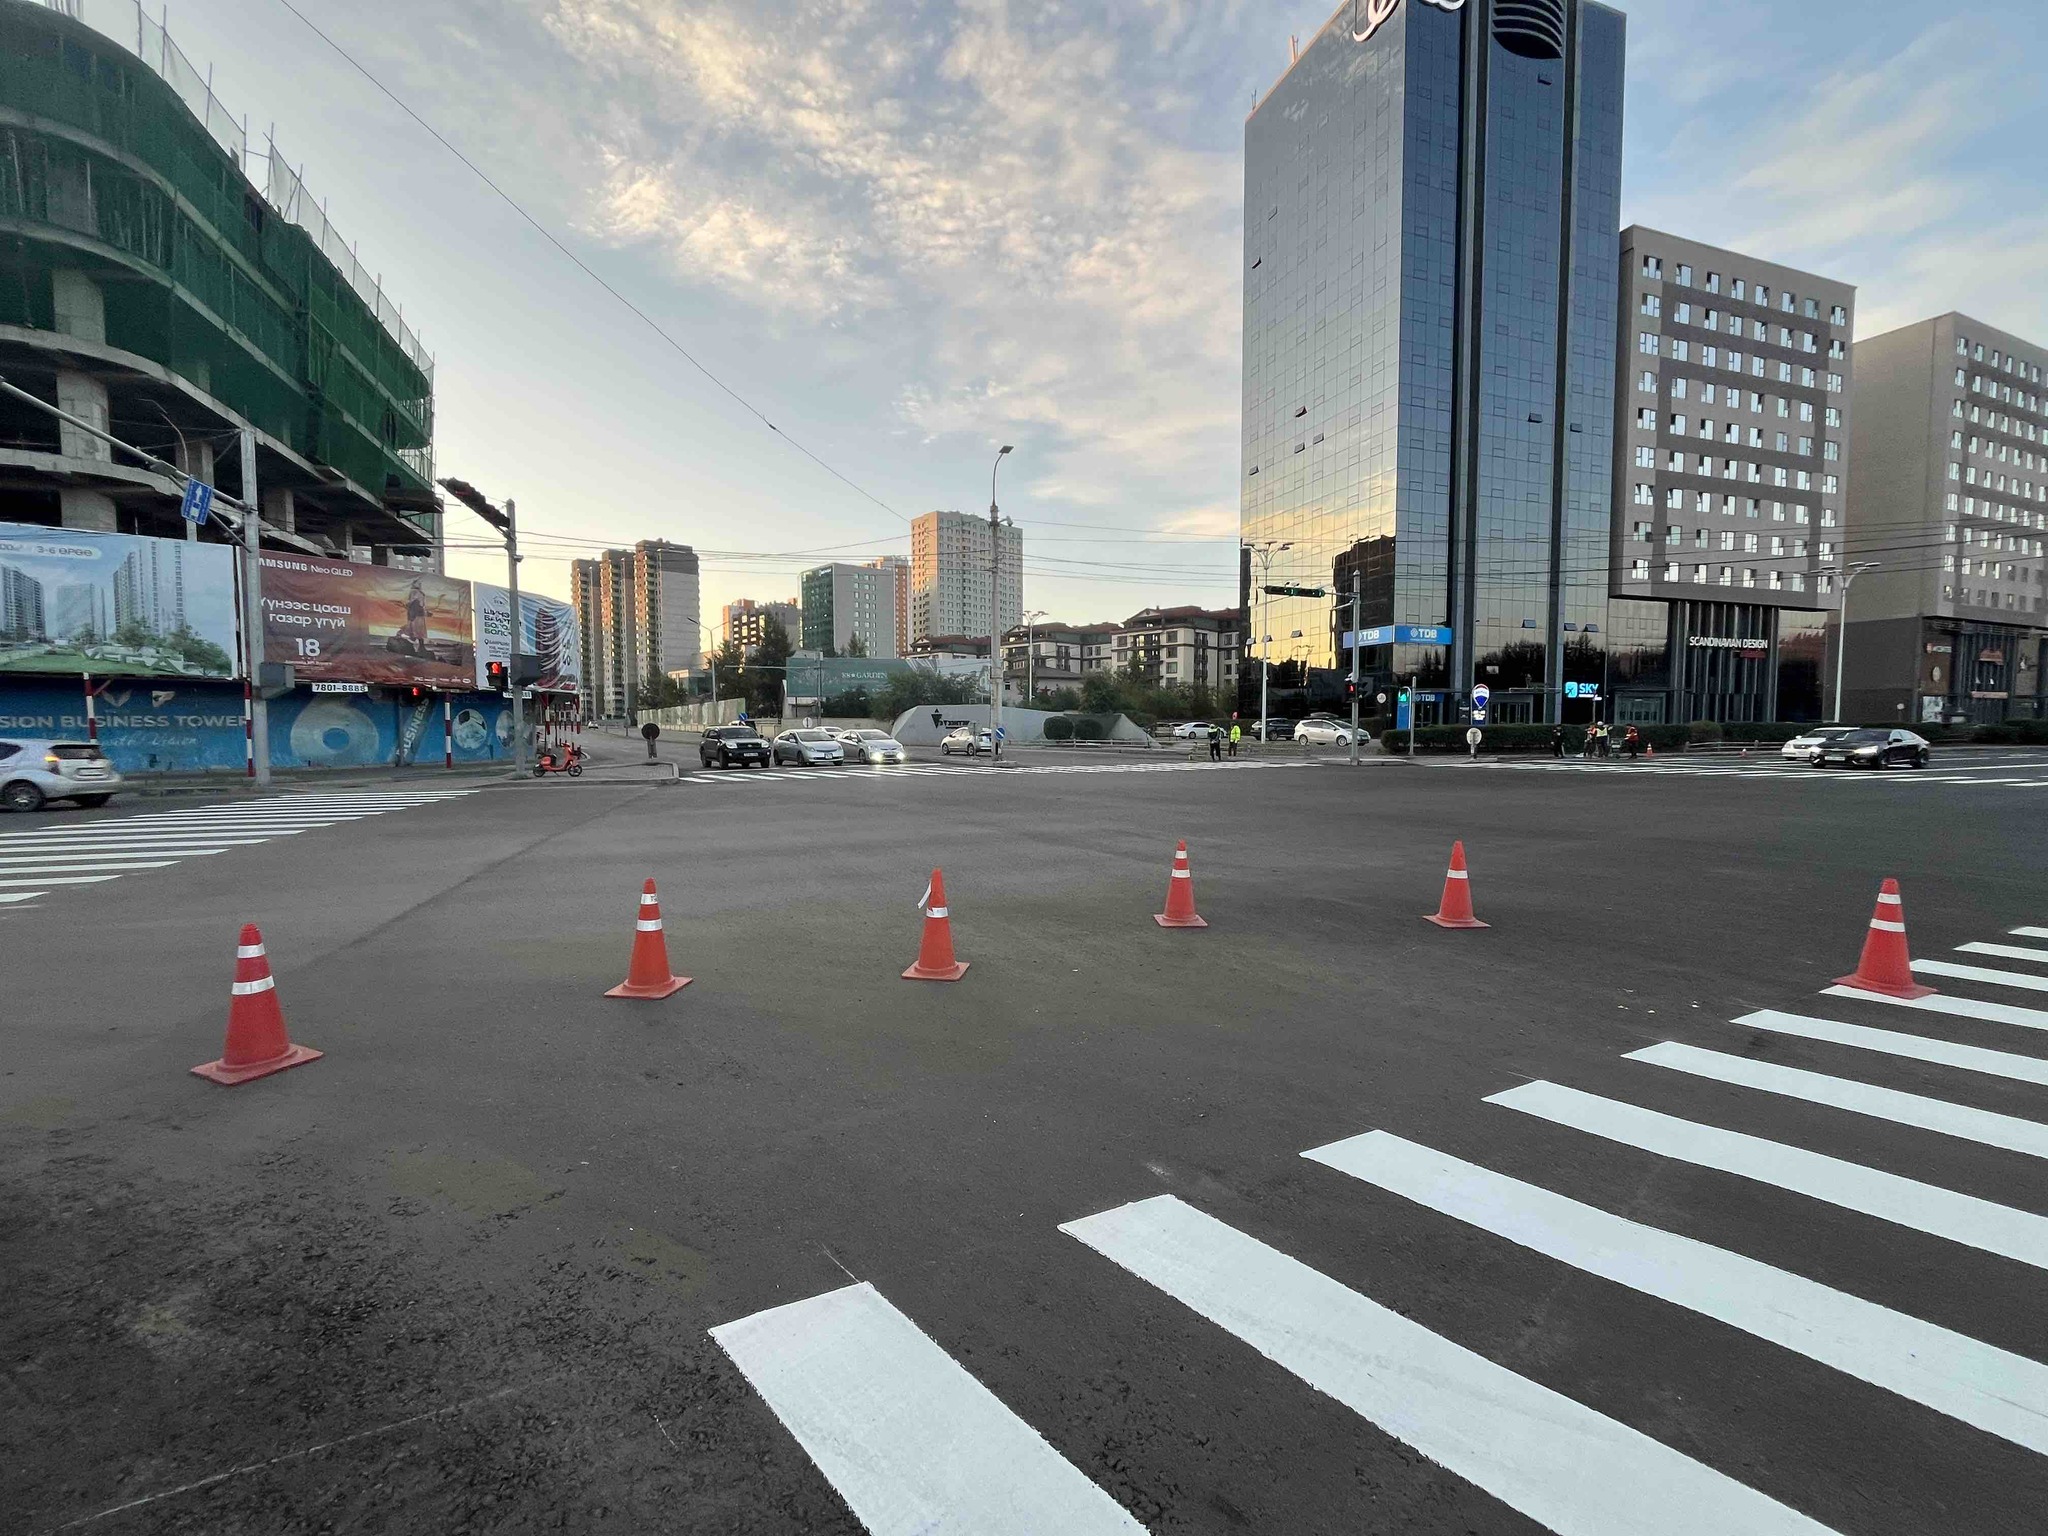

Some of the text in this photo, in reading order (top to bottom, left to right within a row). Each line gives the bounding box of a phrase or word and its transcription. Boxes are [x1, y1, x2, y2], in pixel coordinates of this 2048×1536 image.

[259, 557, 353, 577] AMSUNG Neo QLED
[313, 603, 352, 615] цааш
[269, 613, 346, 629] газар үгүй
[1362, 629, 1380, 640] TDB
[1418, 628, 1438, 639] TDB
[295, 637, 320, 657] 18
[1689, 636, 1768, 649] SCANDINAVIAN DESIGN
[1578, 683, 1599, 694] SKY
[1420, 694, 1436, 702] TDB
[60, 715, 170, 728] BUSINESS
